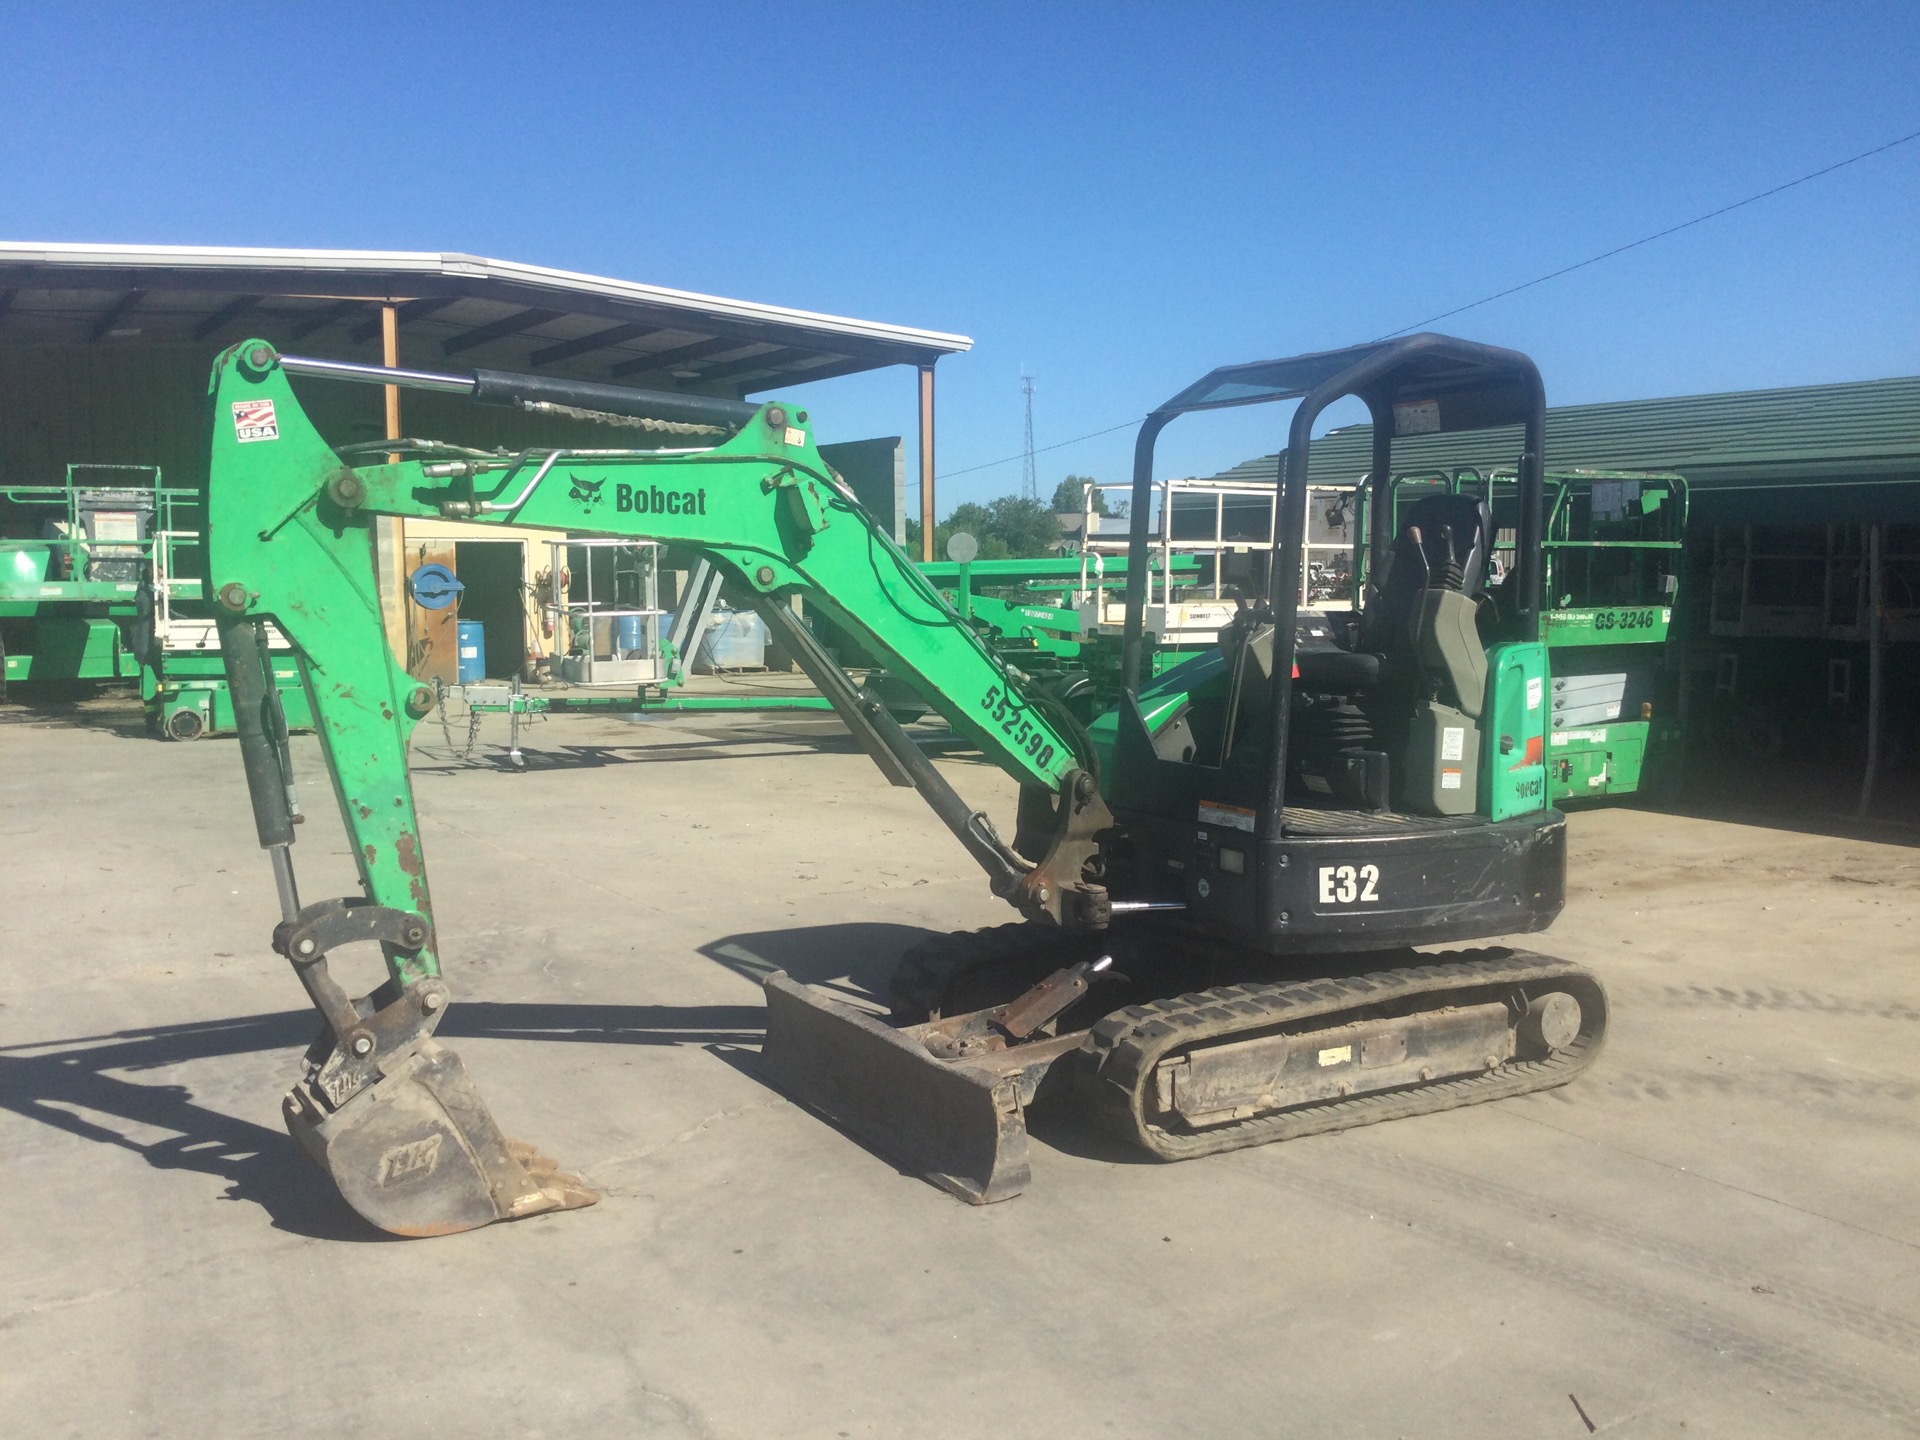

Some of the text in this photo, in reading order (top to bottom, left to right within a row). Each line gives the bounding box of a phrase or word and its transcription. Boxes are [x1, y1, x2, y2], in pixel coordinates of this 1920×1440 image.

[239, 427, 275, 438] USA
[616, 483, 706, 516] Bobcat
[1595, 610, 1654, 631] GS-3246
[981, 684, 1054, 769] 552590
[1319, 864, 1380, 904] E32
